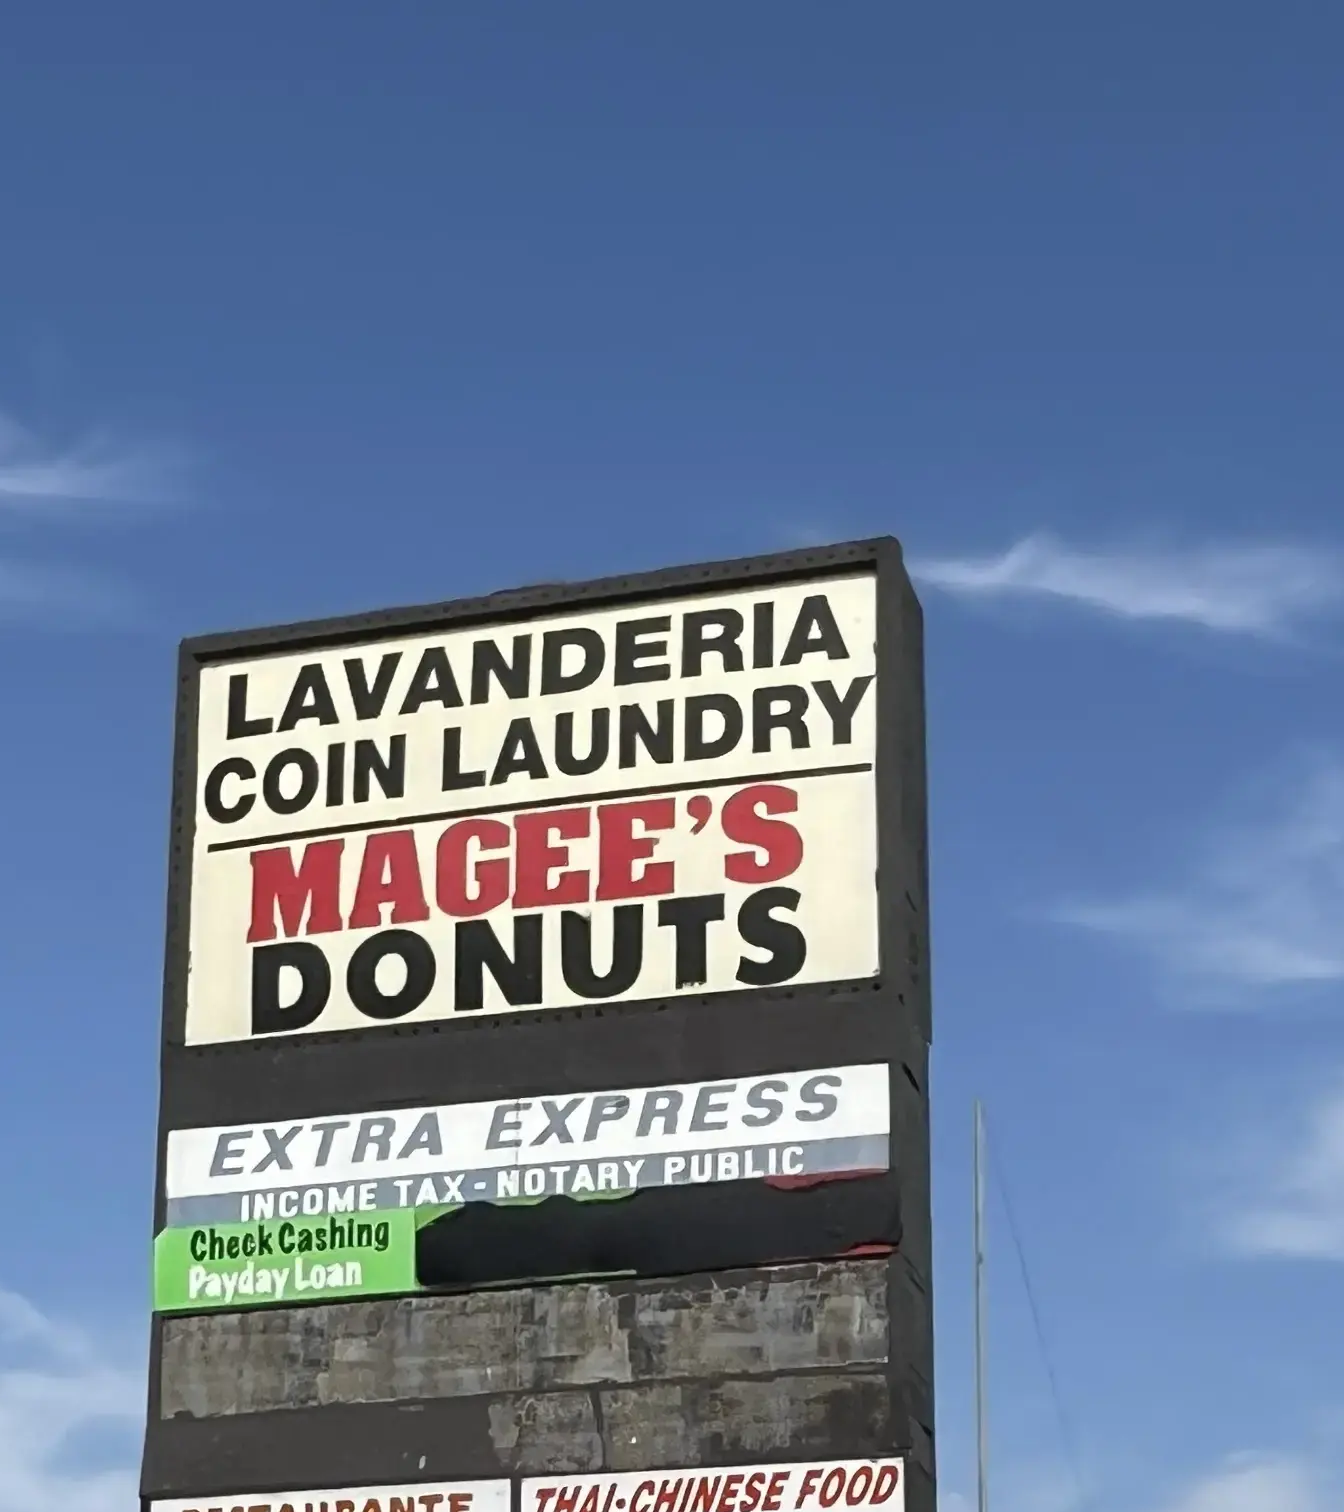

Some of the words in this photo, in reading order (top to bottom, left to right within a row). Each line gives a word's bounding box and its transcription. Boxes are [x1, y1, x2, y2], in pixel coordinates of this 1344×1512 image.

[226, 595, 849, 740] LAVANDERIA
[204, 734, 406, 824] COIN
[441, 674, 875, 793] LAUNDRY
[247, 784, 804, 943] MAGEE'S
[252, 887, 807, 1034] DONUTS
[210, 1112, 444, 1178] EXTRA
[485, 1075, 842, 1150] EXPRESS
[240, 1182, 378, 1223] INCOME
[394, 1174, 466, 1206] TAX
[497, 1159, 645, 1199] NOTARY
[663, 1145, 805, 1185] PUBLIC
[188, 1259, 290, 1304] Payday
[295, 1257, 362, 1291] Loan
[190, 1224, 273, 1261] Check
[278, 1217, 390, 1256] Cashing
[795, 1465, 899, 1510] FOOD
